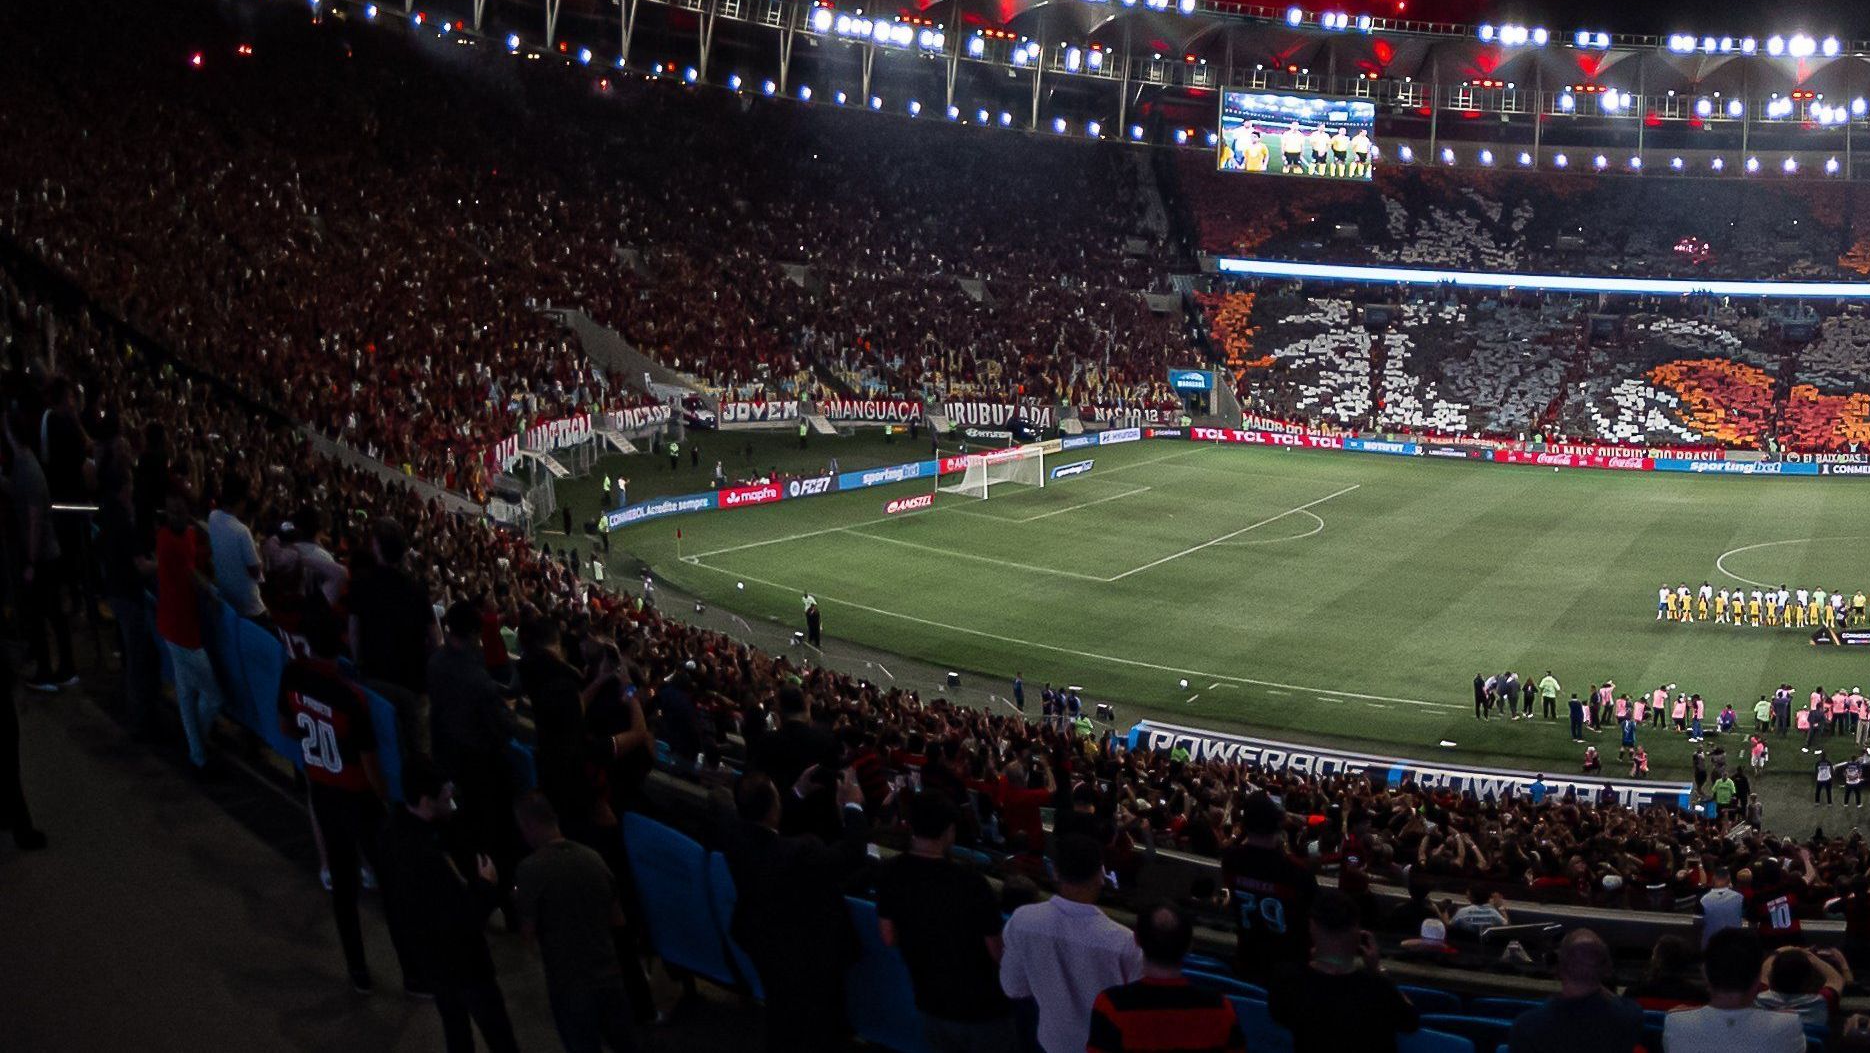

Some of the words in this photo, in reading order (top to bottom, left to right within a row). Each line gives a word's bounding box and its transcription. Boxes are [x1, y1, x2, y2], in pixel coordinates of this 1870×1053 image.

[723, 401, 797, 421] JOVEM
[831, 401, 920, 423] MANGUAÇA
[1194, 428, 1227, 441] TCL
[1232, 430, 1265, 443] TCL
[1270, 433, 1303, 446] TCL
[1309, 436, 1342, 449] TCL
[1536, 452, 1571, 465] Coca-Cola
[1608, 455, 1643, 469] Coca-Cola
[863, 463, 919, 485] sportingbet
[1690, 461, 1781, 474] sportingbet
[800, 477, 831, 496] FC27
[741, 487, 777, 503] mapfre
[897, 496, 933, 511] AMSTEL
[296, 712, 343, 774] 20
